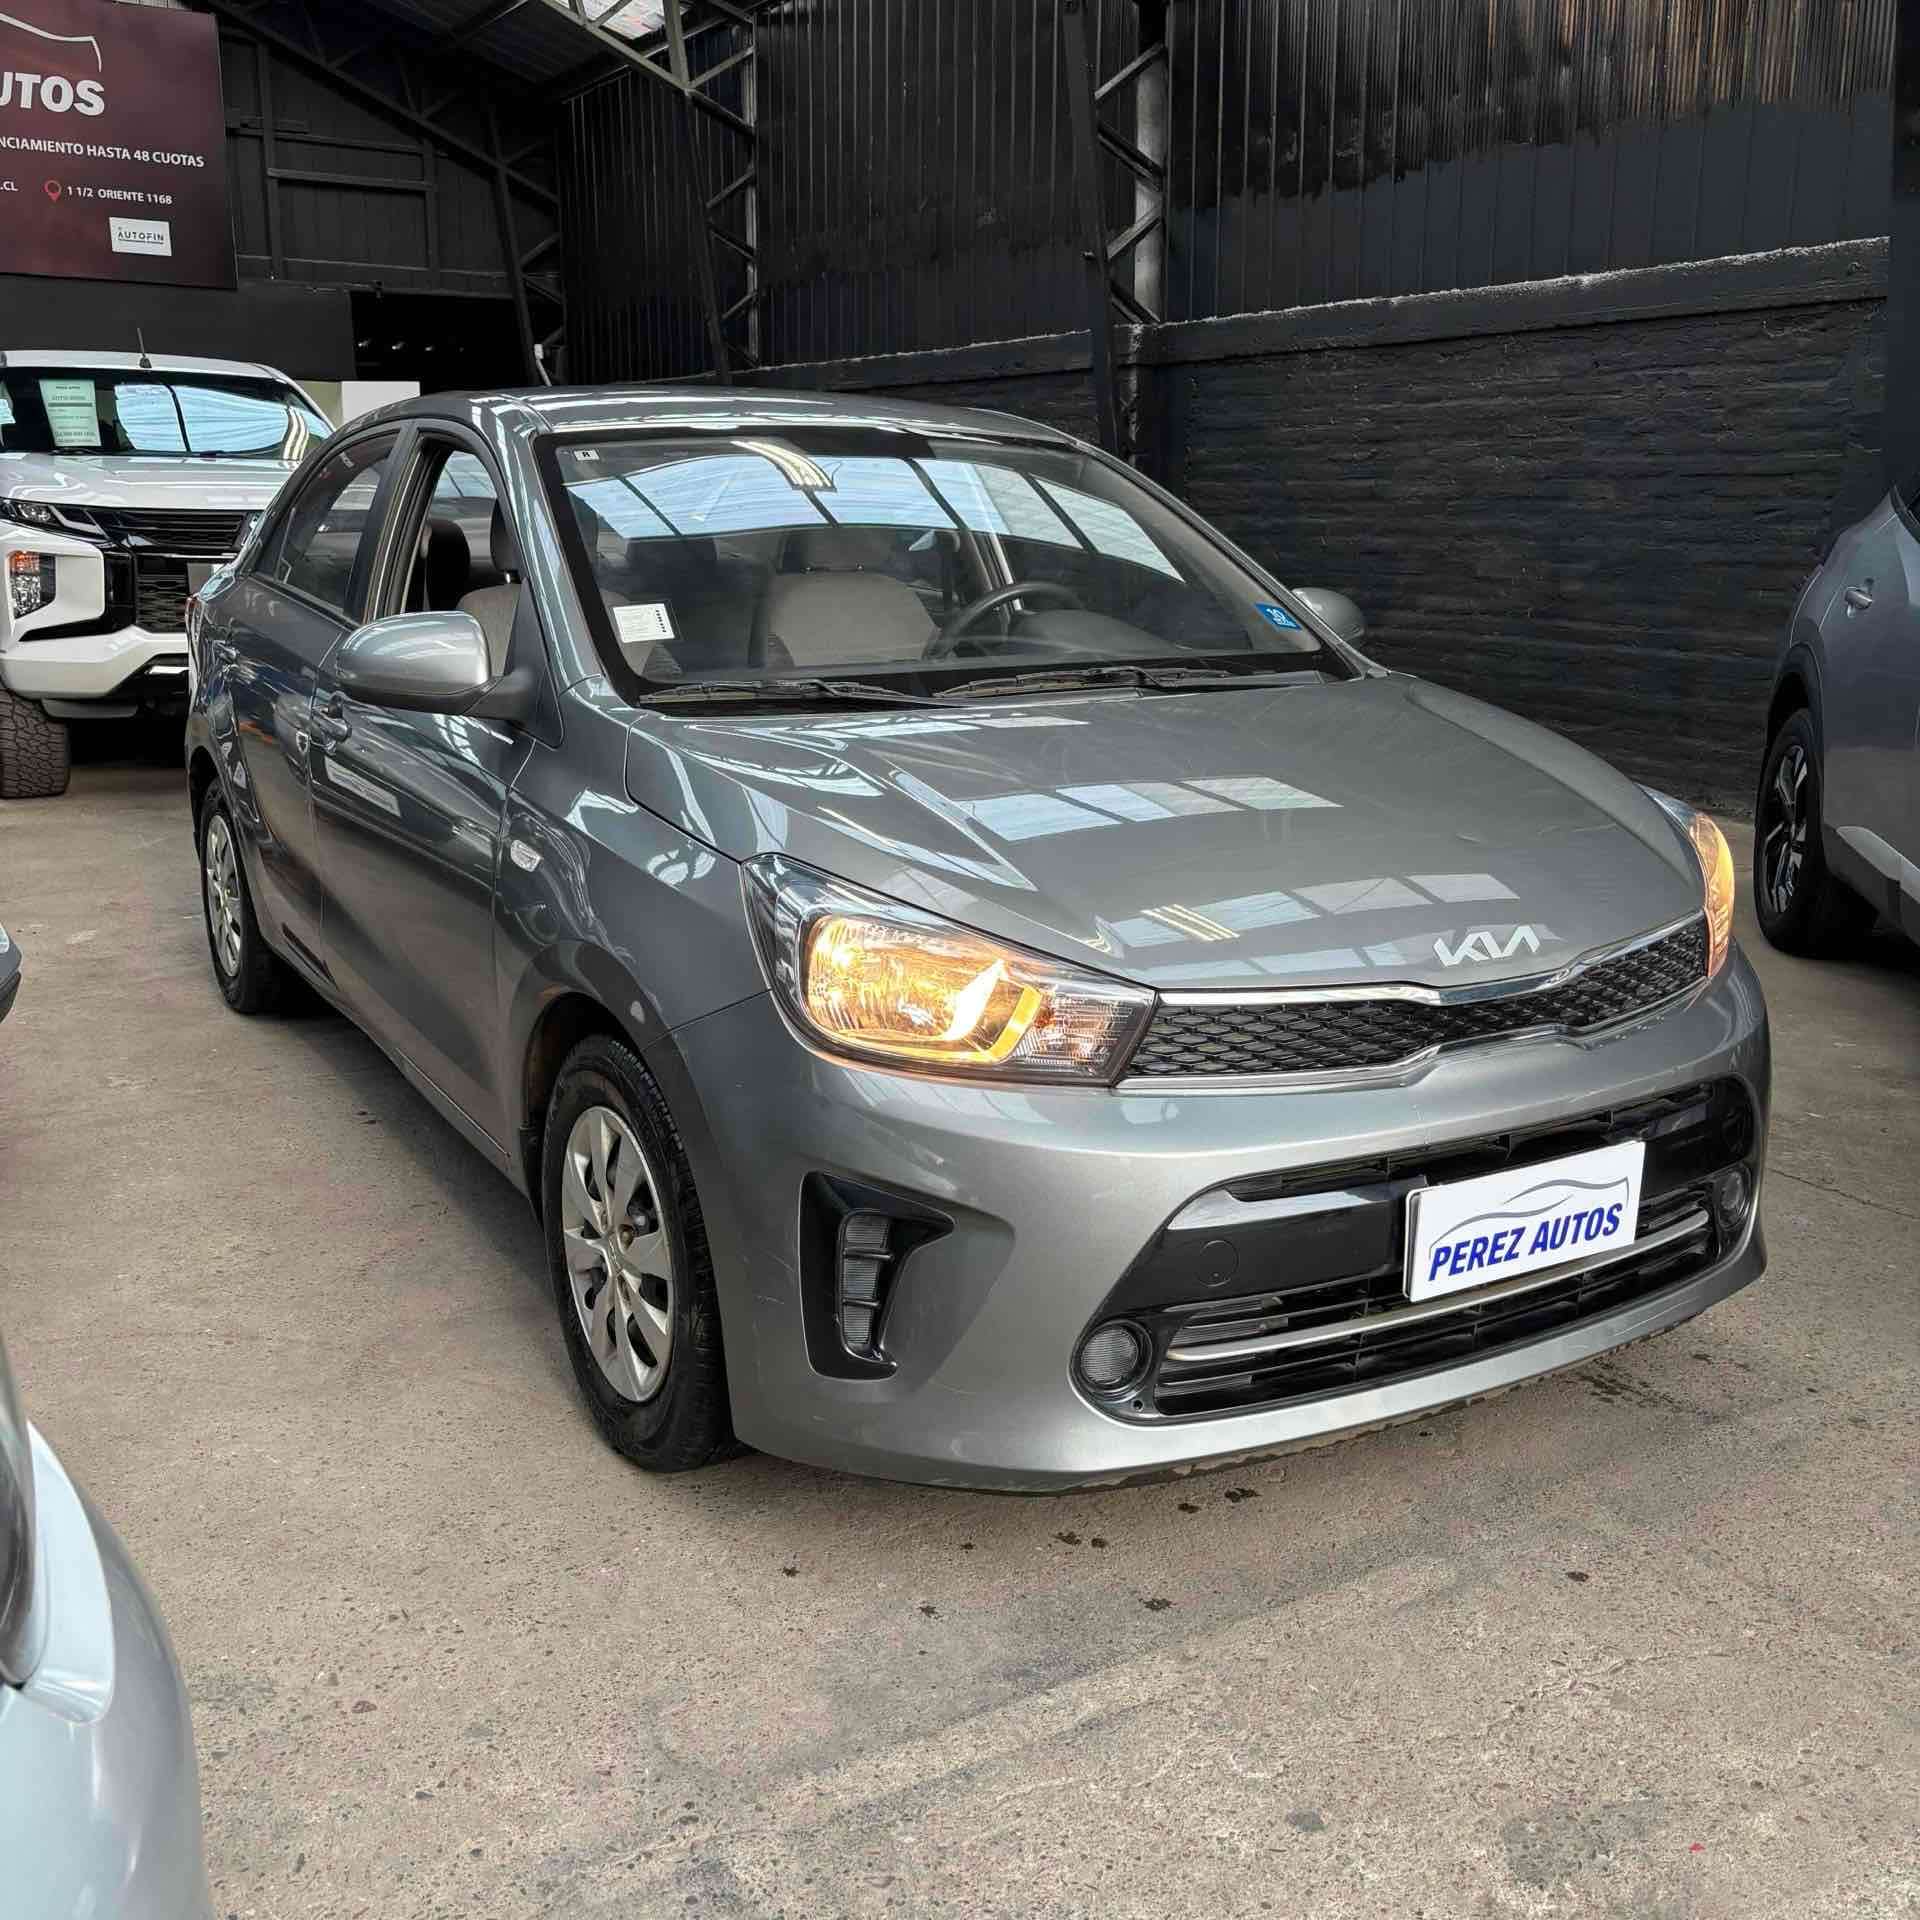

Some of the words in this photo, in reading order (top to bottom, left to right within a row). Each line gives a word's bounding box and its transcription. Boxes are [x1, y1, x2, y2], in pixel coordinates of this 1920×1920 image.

[0, 136, 84, 155] NCIAMIENTO
[86, 144, 131, 160] HASTA
[133, 150, 150, 162] 48
[152, 151, 205, 168] CUOTAS
[67, 186, 73, 196] 1
[76, 187, 94, 198] 1/2
[97, 188, 145, 202] ORIENTE
[145, 193, 173, 205] 1168
[117, 230, 165, 242] AUTOFIN
[1432, 924, 1541, 967] KIA
[1428, 1226, 1527, 1281] PEREZ
[1528, 1202, 1624, 1256] AUTOS
